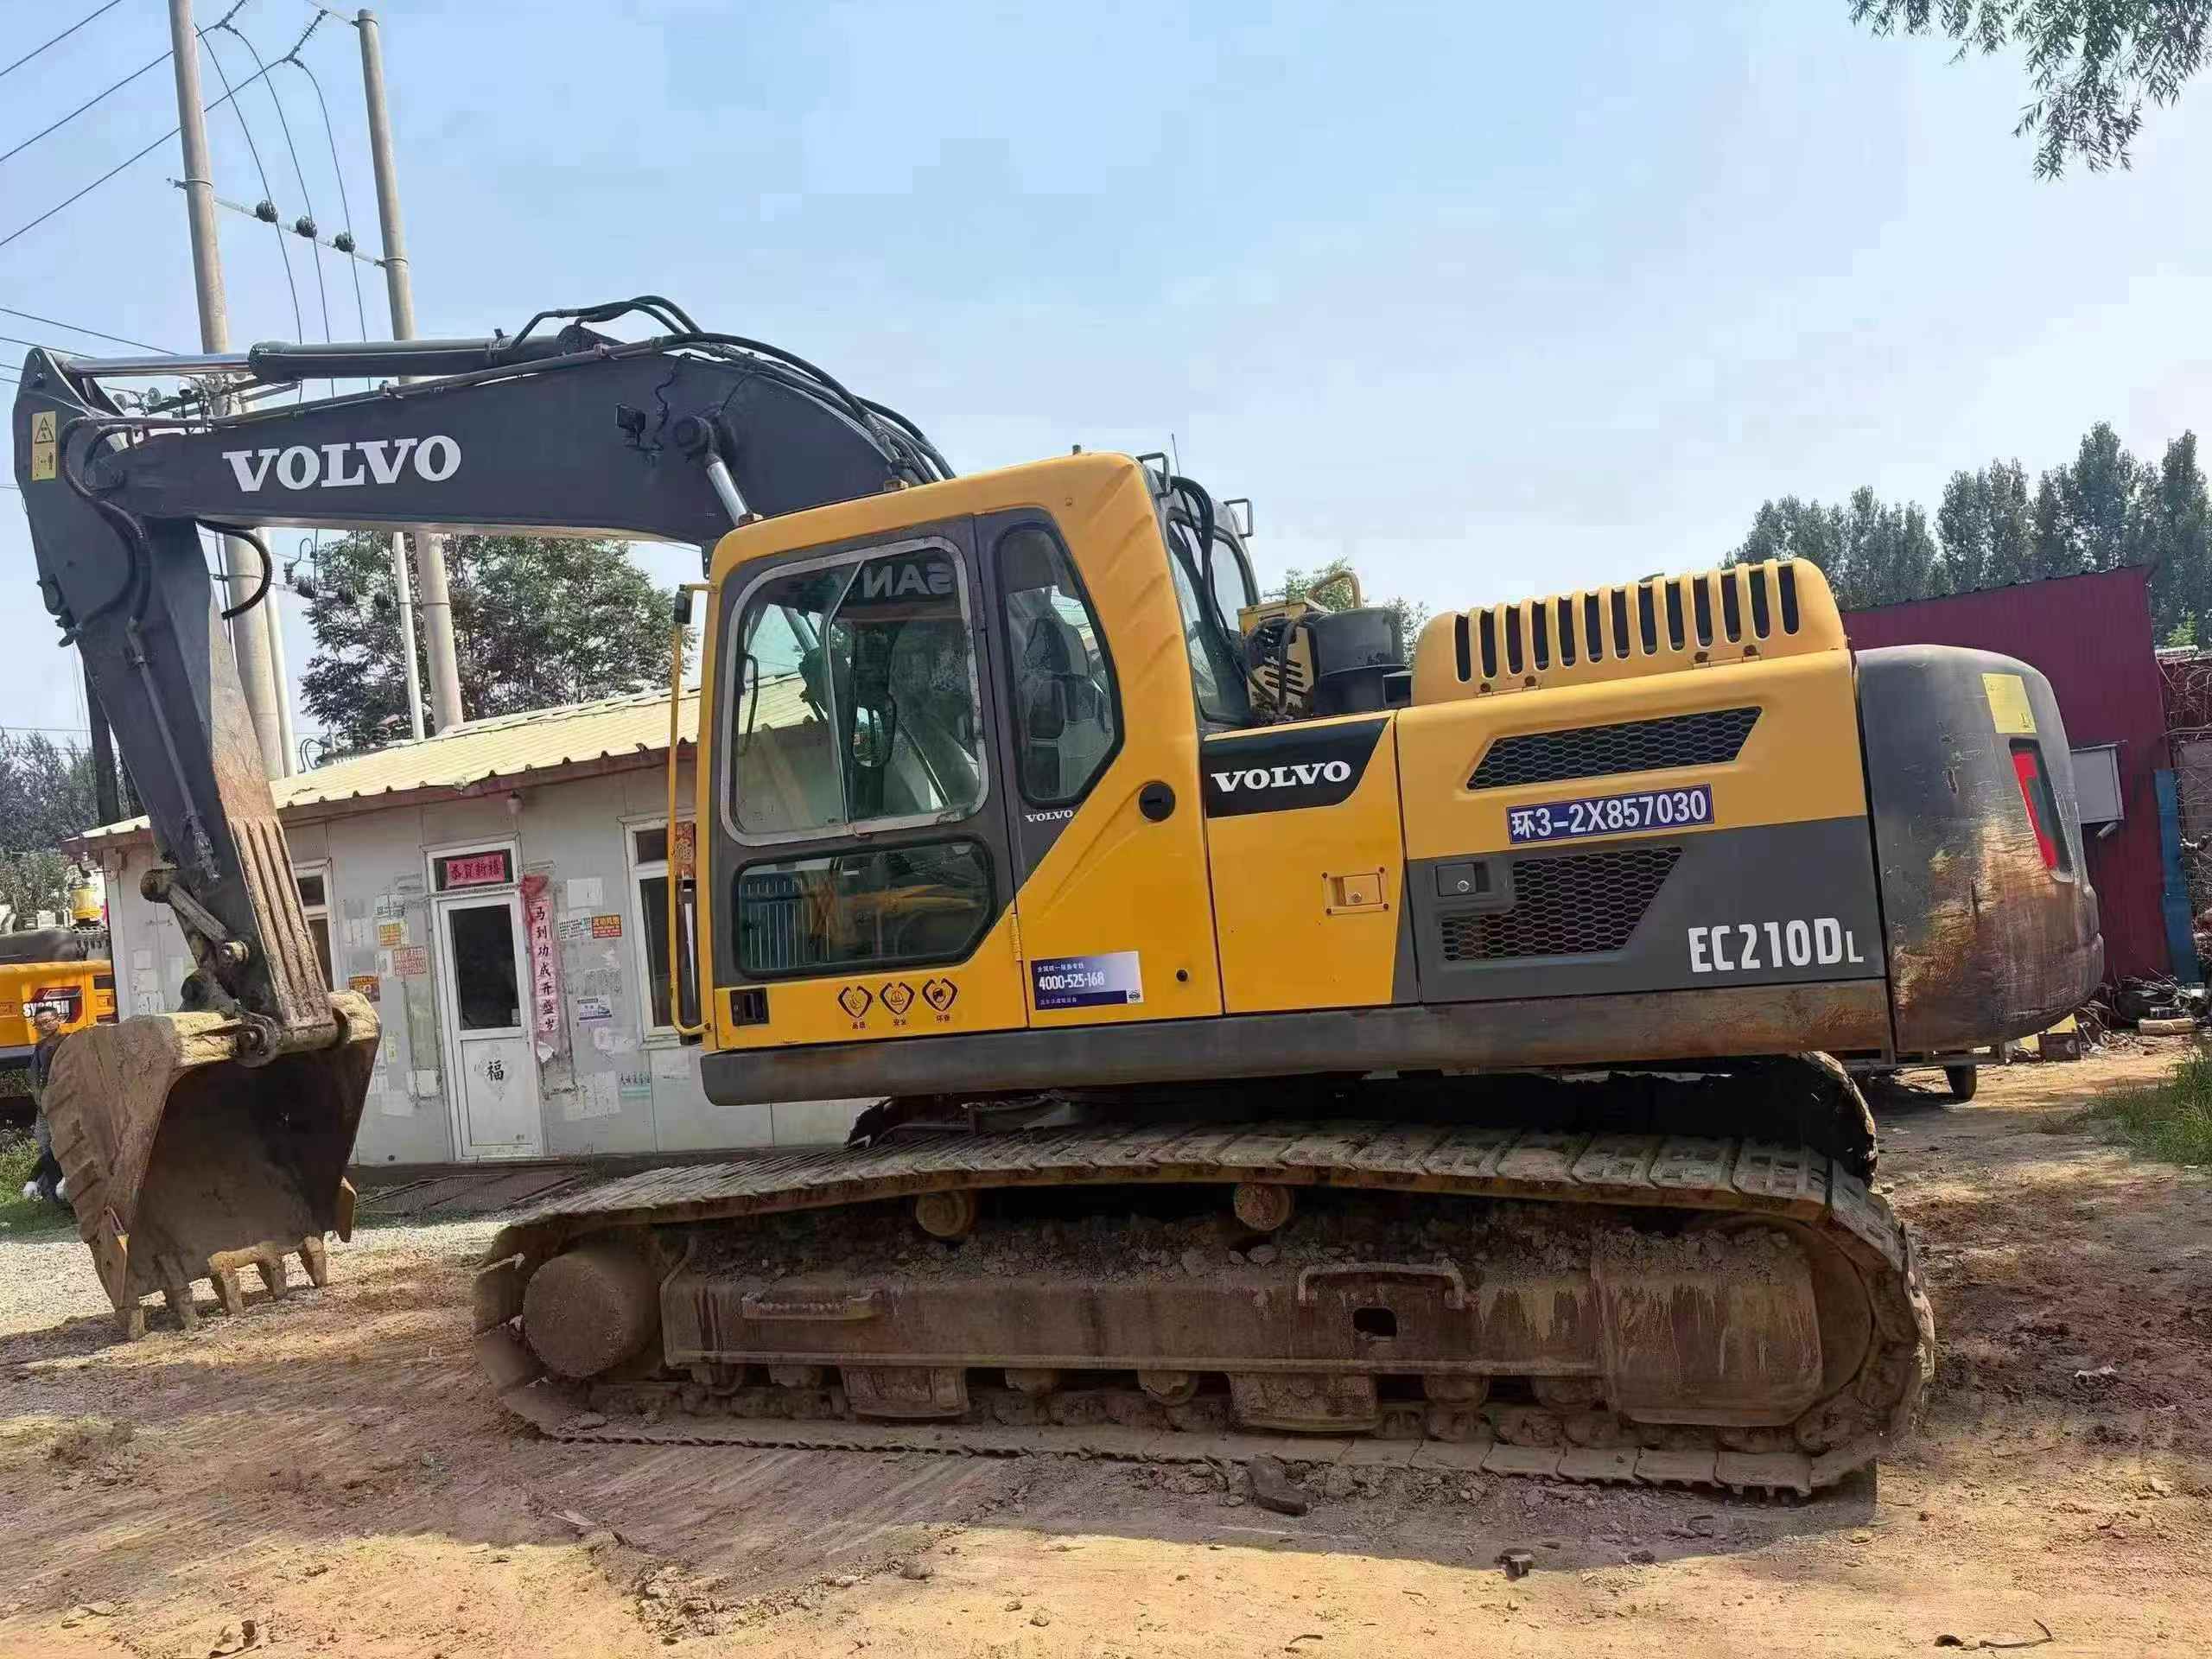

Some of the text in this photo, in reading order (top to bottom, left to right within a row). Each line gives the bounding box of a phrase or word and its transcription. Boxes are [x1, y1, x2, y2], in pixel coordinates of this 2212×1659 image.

[222, 435, 461, 492] VOLVO
[1211, 760, 1351, 792] VOLVO
[1025, 810, 1074, 822] VOLVO
[1511, 790, 1707, 838] 环3-2X857030
[1688, 918, 1865, 973] EC210DL
[1039, 971, 1105, 990] 4000-525-168
[486, 1059, 505, 1082] 福
